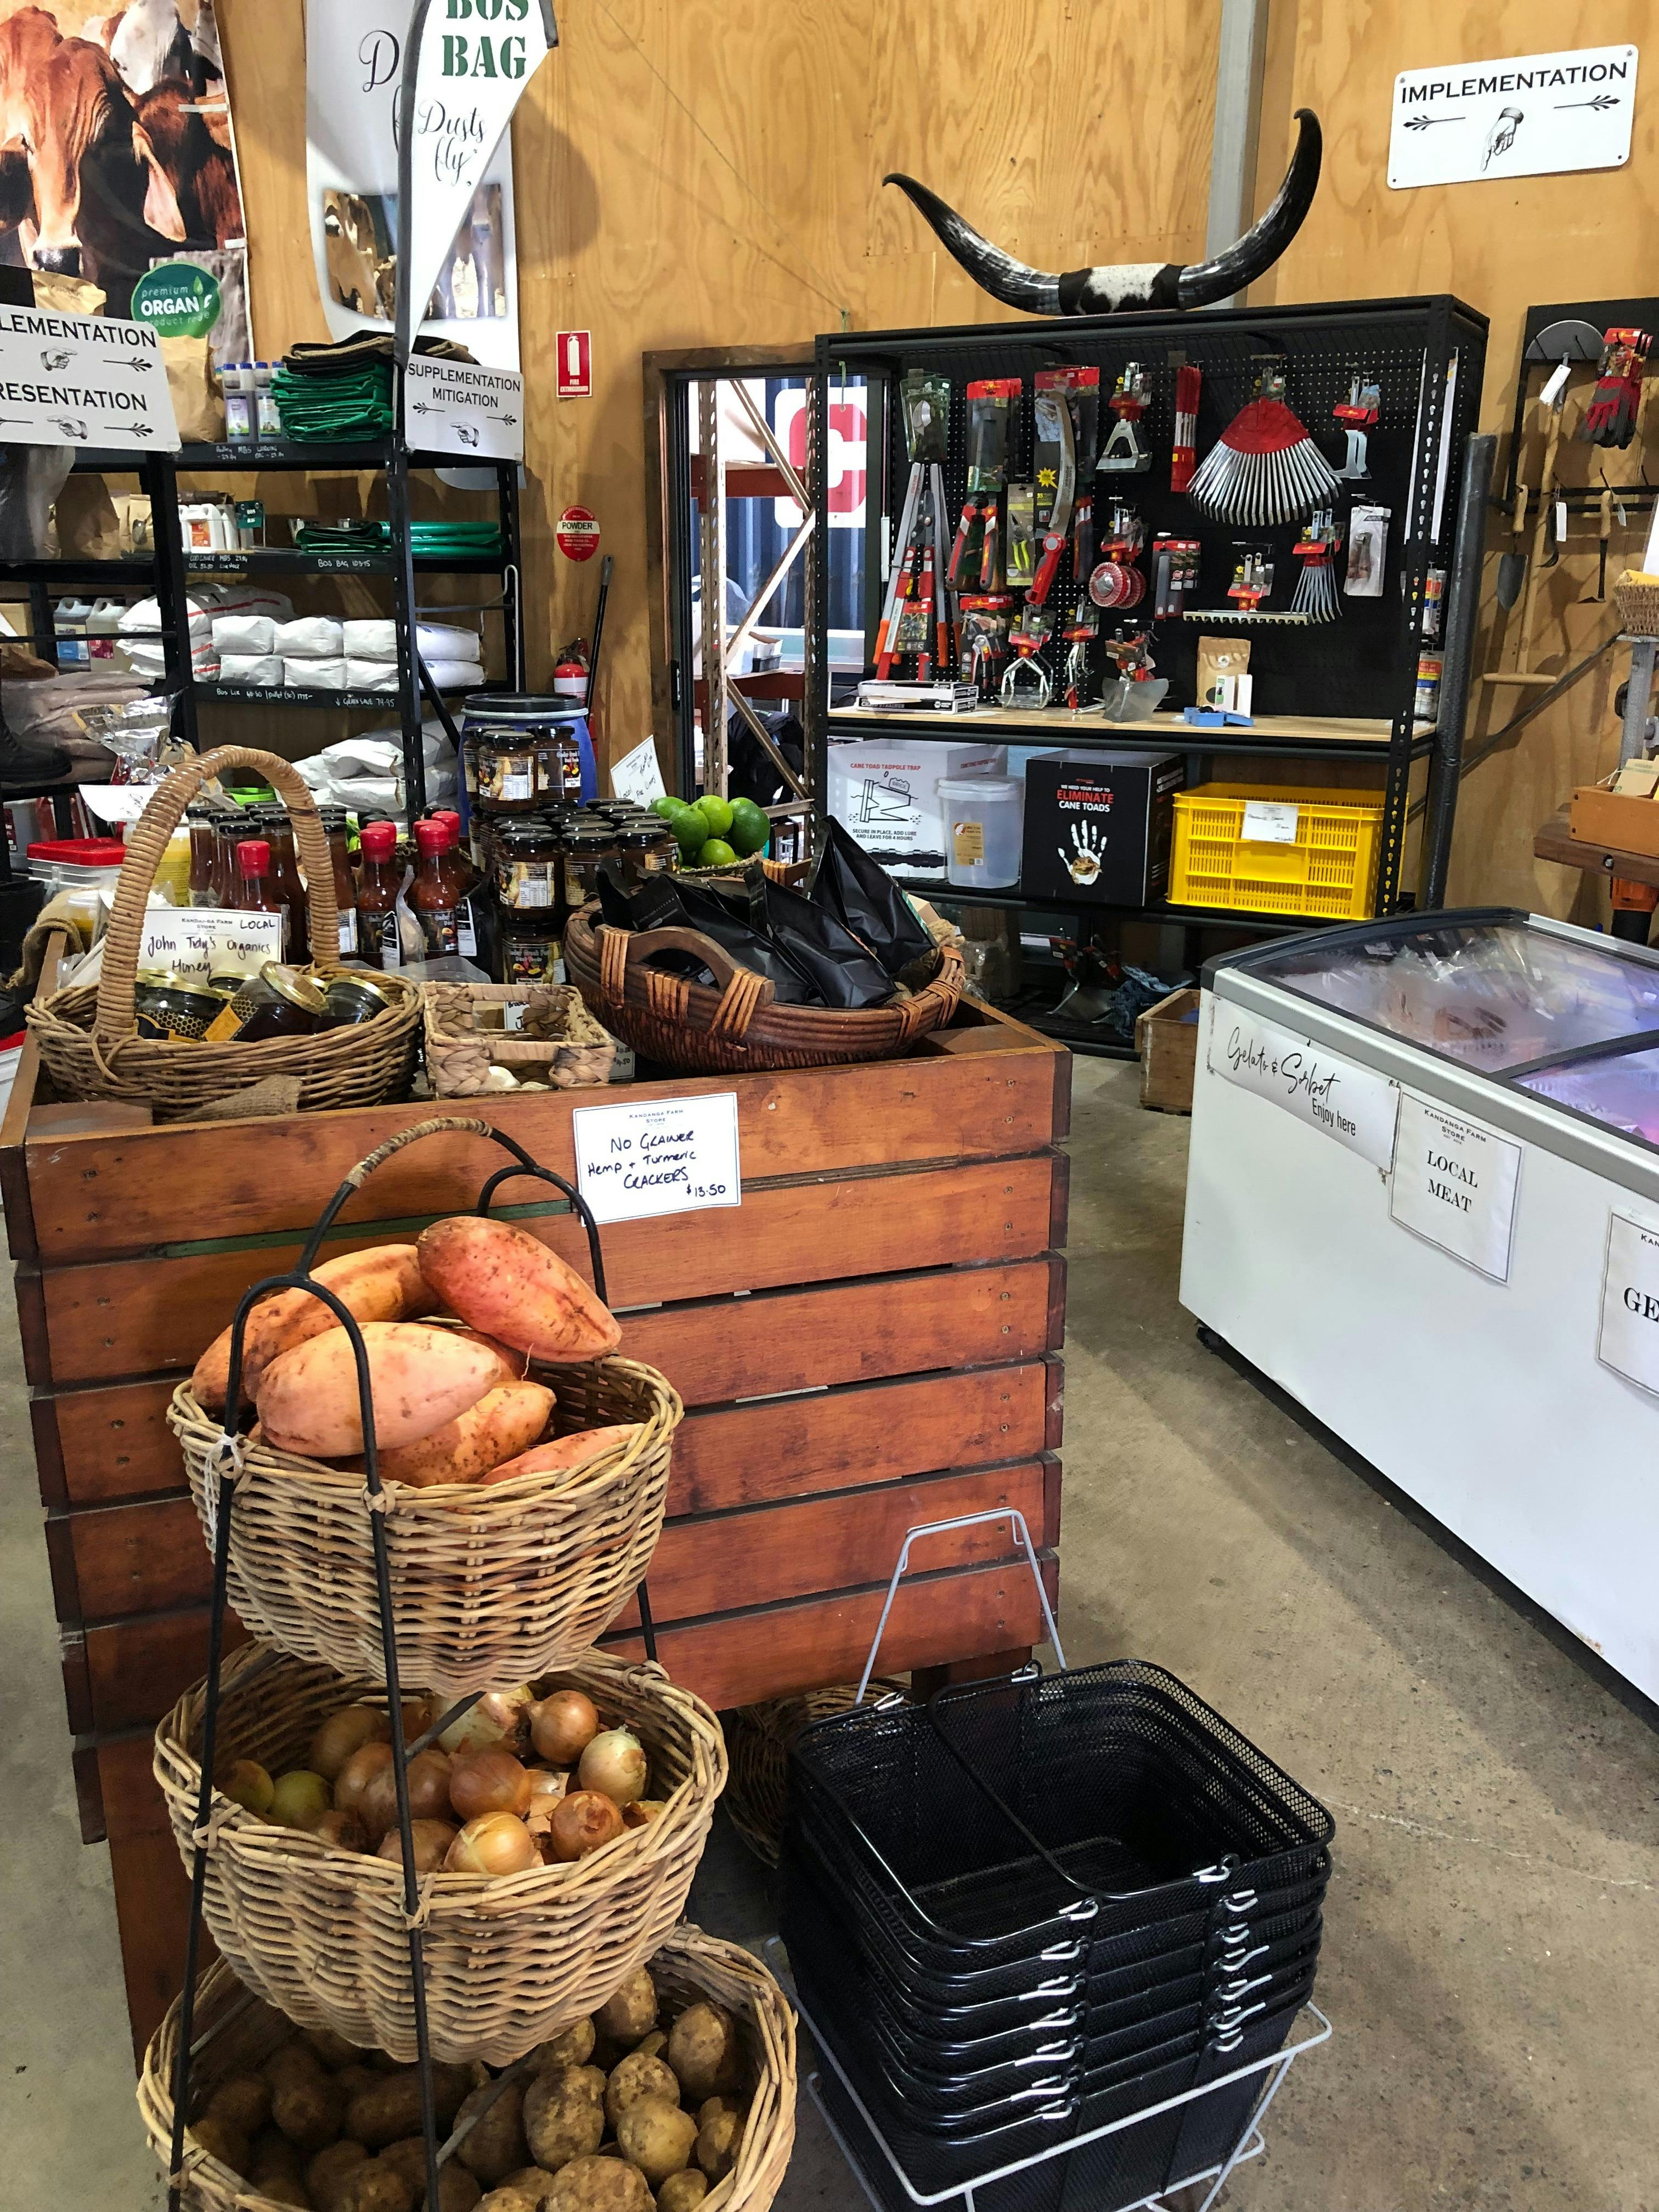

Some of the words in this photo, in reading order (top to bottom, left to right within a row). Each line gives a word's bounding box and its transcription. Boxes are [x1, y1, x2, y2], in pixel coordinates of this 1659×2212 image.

[442, 35, 527, 79] BAG
[1401, 61, 1627, 104] IMPLEMENTATION
[418, 98, 488, 143] Dusts
[142, 286, 188, 299] premium
[0, 314, 157, 348] LEMENTATION
[408, 363, 521, 392] SUPPLEMENTATION
[432, 387, 499, 408] MITIGATION
[562, 521, 593, 530] POWDER
[1057, 789, 1114, 804] ELIMINATE
[1059, 800, 1081, 810] CANE
[1082, 802, 1110, 812] TOADS
[240, 919, 276, 930] LOCAL
[148, 935, 177, 958] John
[1227, 1026, 1269, 1076] Gelato
[1280, 1052, 1341, 1103] Sorbet
[1312, 1097, 1335, 1127] Enjoy
[1337, 1110, 1356, 1136] here
[1424, 1108, 1464, 1132] KANDANGA
[1466, 1128, 1486, 1142] FARM
[610, 1137, 632, 1153] NO
[1441, 1125, 1465, 1142] STORE
[1426, 1149, 1479, 1188] LOCAL
[1427, 1178, 1472, 1214] MEAT
[1623, 1287, 1659, 1323] GE
